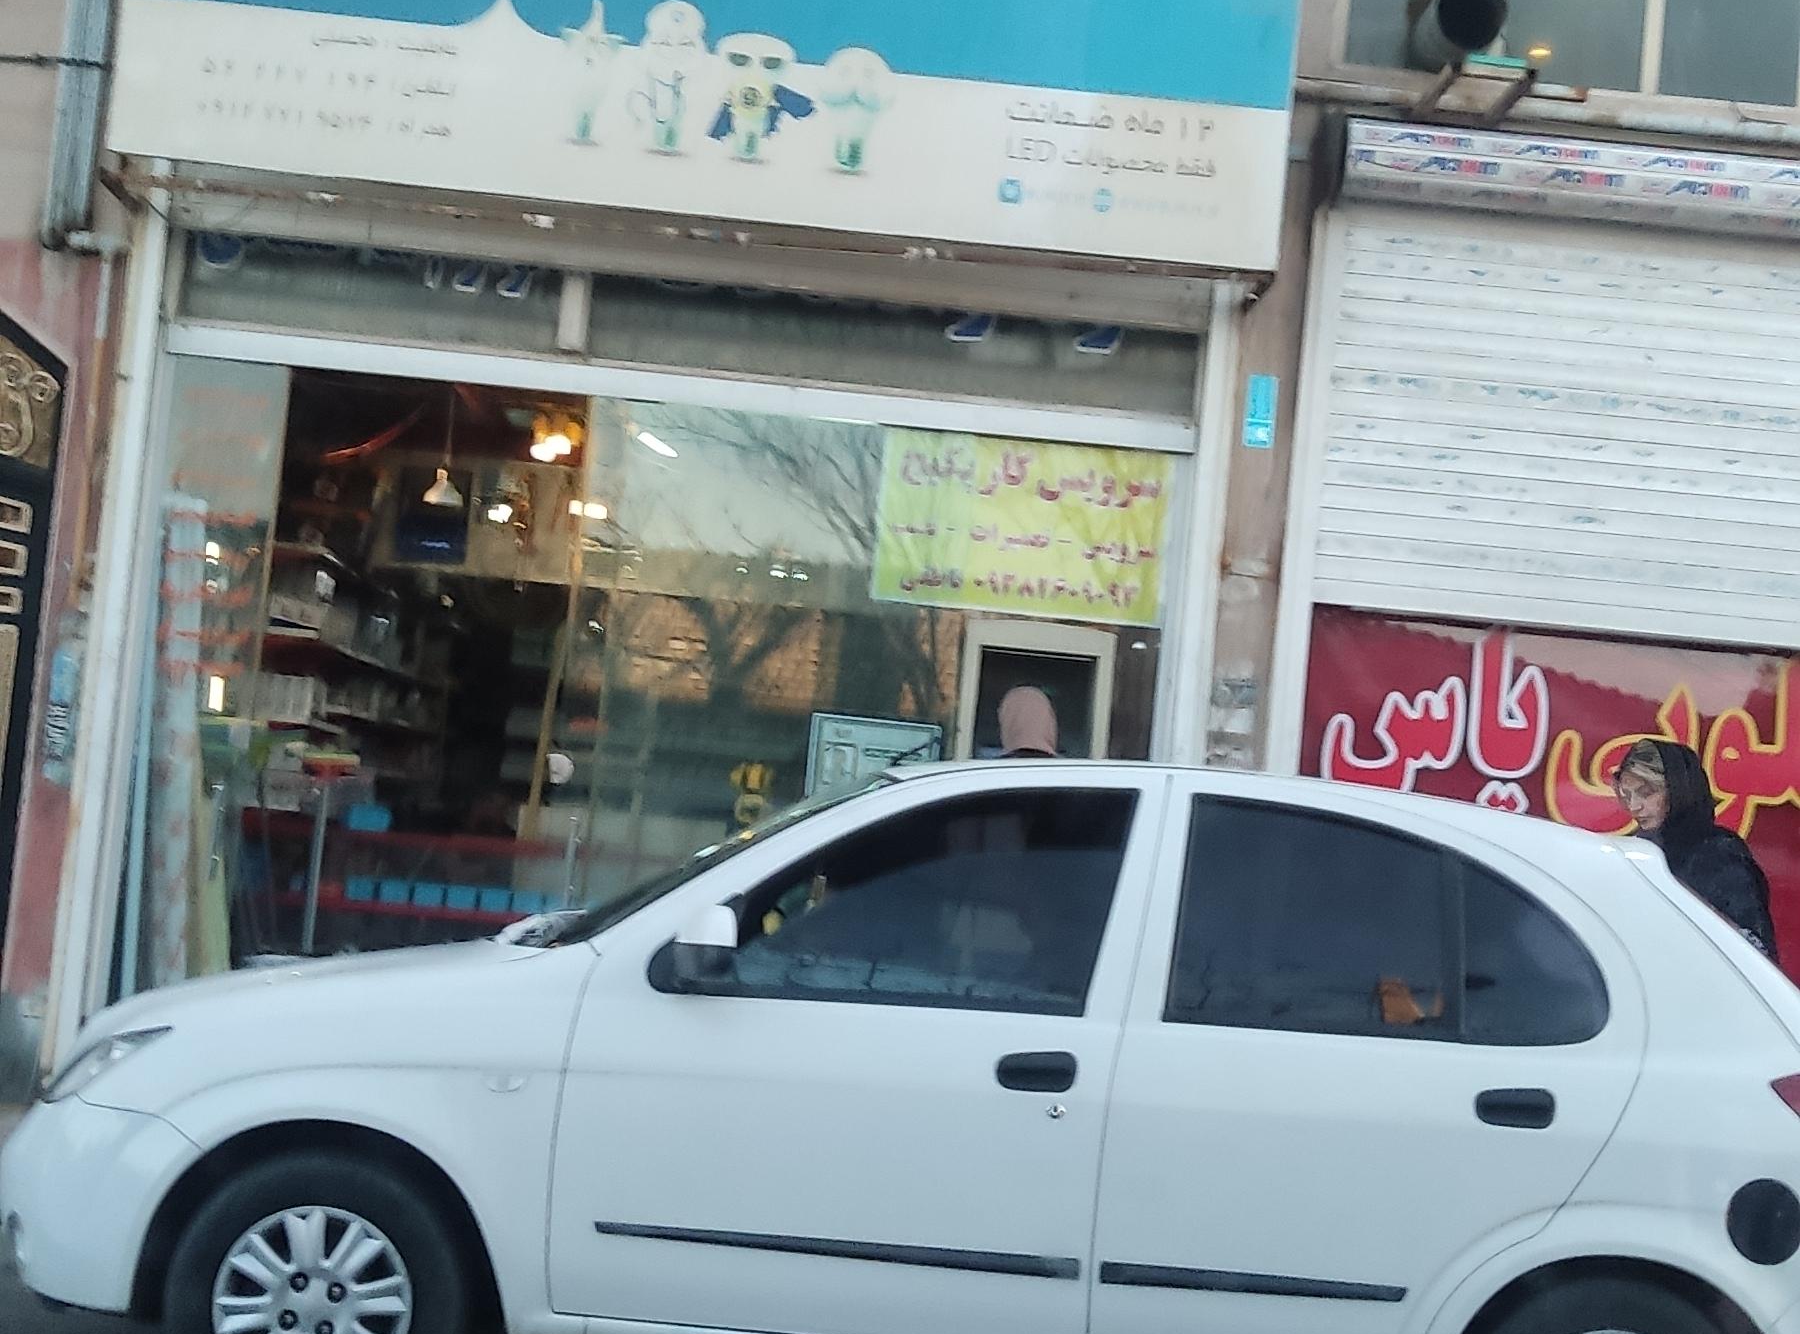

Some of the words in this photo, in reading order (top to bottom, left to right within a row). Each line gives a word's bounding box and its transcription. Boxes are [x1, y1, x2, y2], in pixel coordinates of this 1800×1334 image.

[1005, 100, 1115, 130] ضمانت
[1124, 110, 1166, 135] ماه
[1006, 136, 1058, 162] LED
[1175, 156, 1217, 179] فقط
[1036, 468, 1163, 509] سرویس
[1319, 630, 1551, 815] یاس
